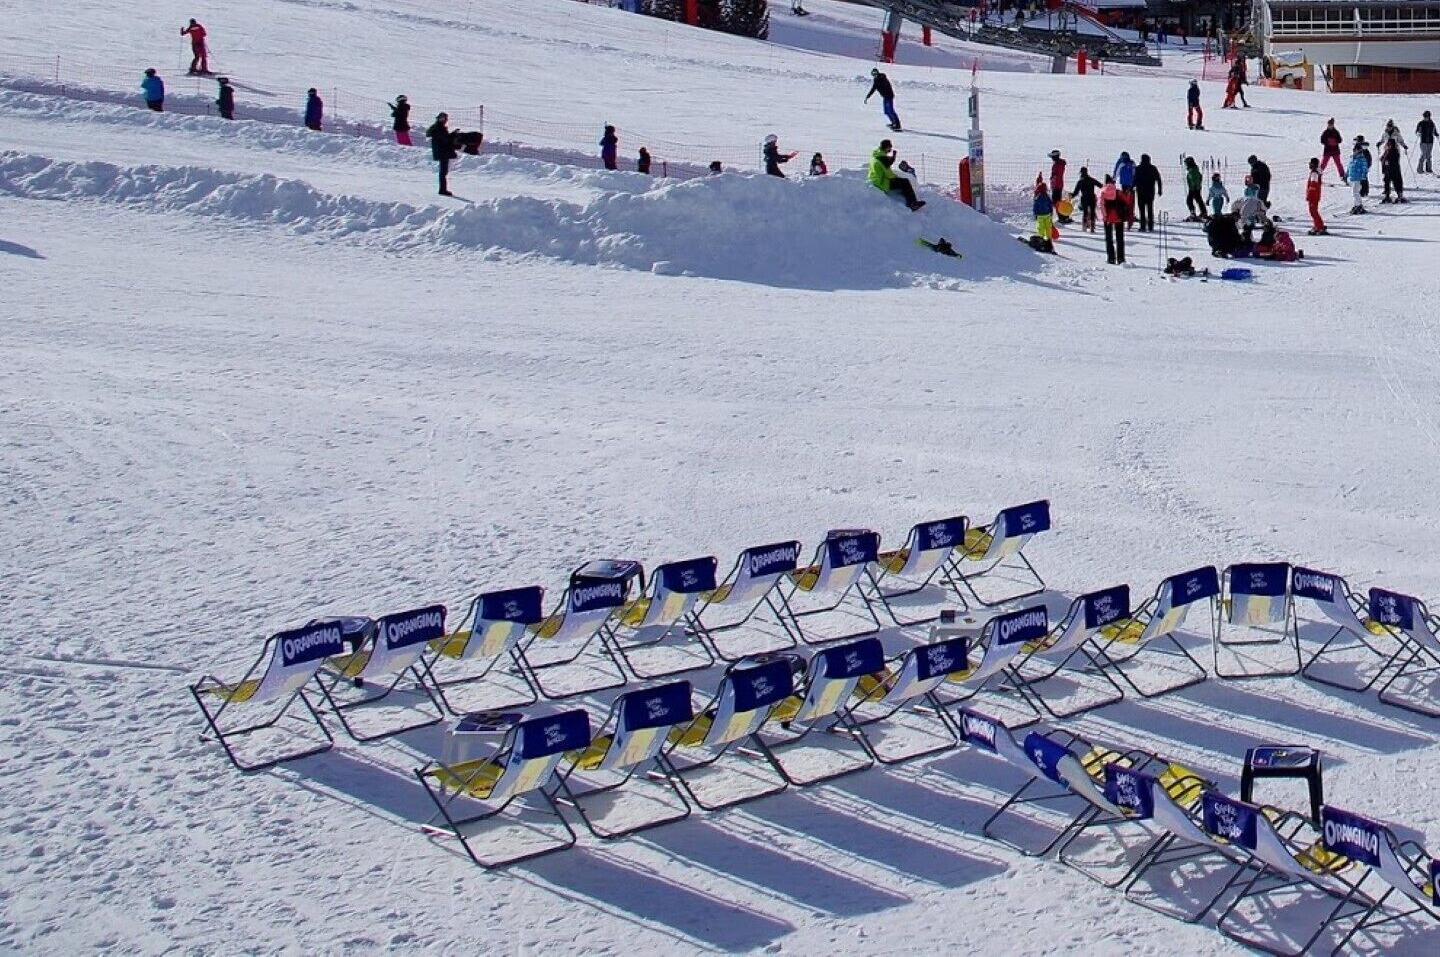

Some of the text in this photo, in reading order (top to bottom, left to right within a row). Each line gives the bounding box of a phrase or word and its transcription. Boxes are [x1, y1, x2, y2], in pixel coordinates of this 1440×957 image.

[751, 547, 794, 572] ORANGINA
[573, 583, 621, 606] ORANGINA
[388, 612, 442, 642] ORANGINA
[1000, 612, 1046, 640] ORANGINA
[285, 628, 340, 660] ORANGINA
[1324, 820, 1378, 856] ORANGINA
